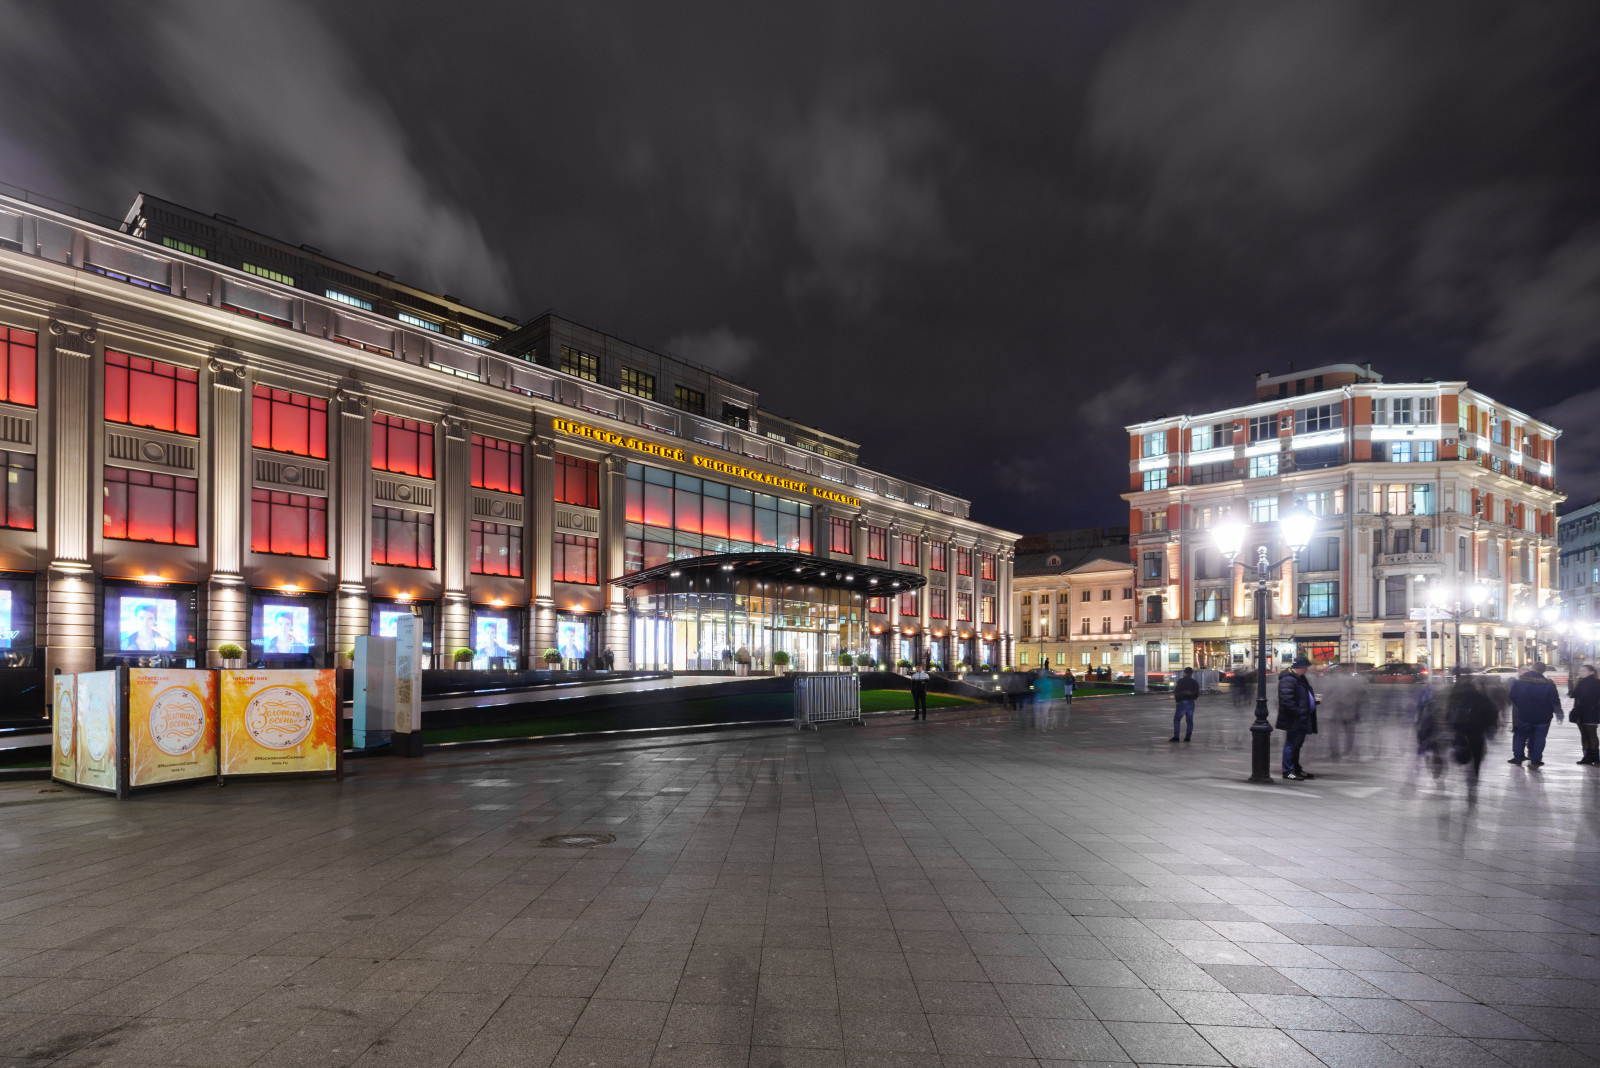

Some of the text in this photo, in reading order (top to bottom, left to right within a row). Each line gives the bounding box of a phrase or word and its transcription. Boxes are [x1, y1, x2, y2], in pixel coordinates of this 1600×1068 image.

[556, 419, 861, 507] ЦЕНТРАЛЬНЫЙ УНИВЕРСАЛЬНЫЙ МАГАЗИН
[269, 717, 294, 725] осень
